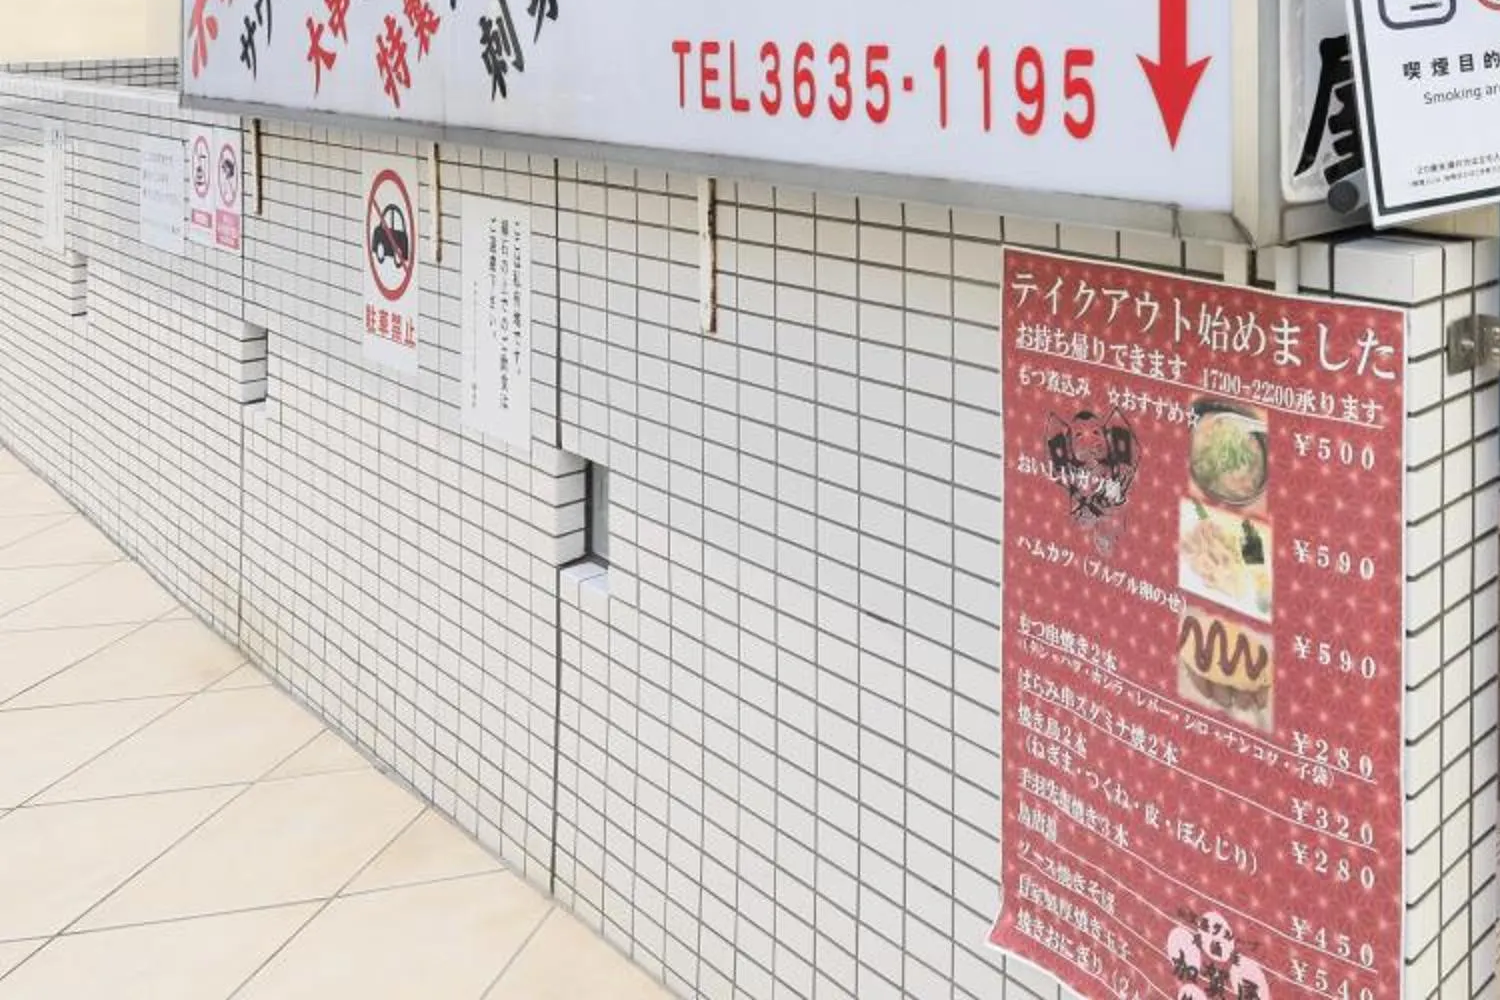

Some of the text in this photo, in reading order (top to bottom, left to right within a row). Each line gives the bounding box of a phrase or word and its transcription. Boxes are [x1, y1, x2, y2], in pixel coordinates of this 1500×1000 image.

[1423, 87, 1482, 106] Smoking
[366, 303, 417, 348] 駐車禁止
[1011, 272, 1397, 380] テイクアウト始めました
[1015, 322, 1188, 381] お持ち帰りできます
[1018, 366, 1092, 398] もつ煮込み
